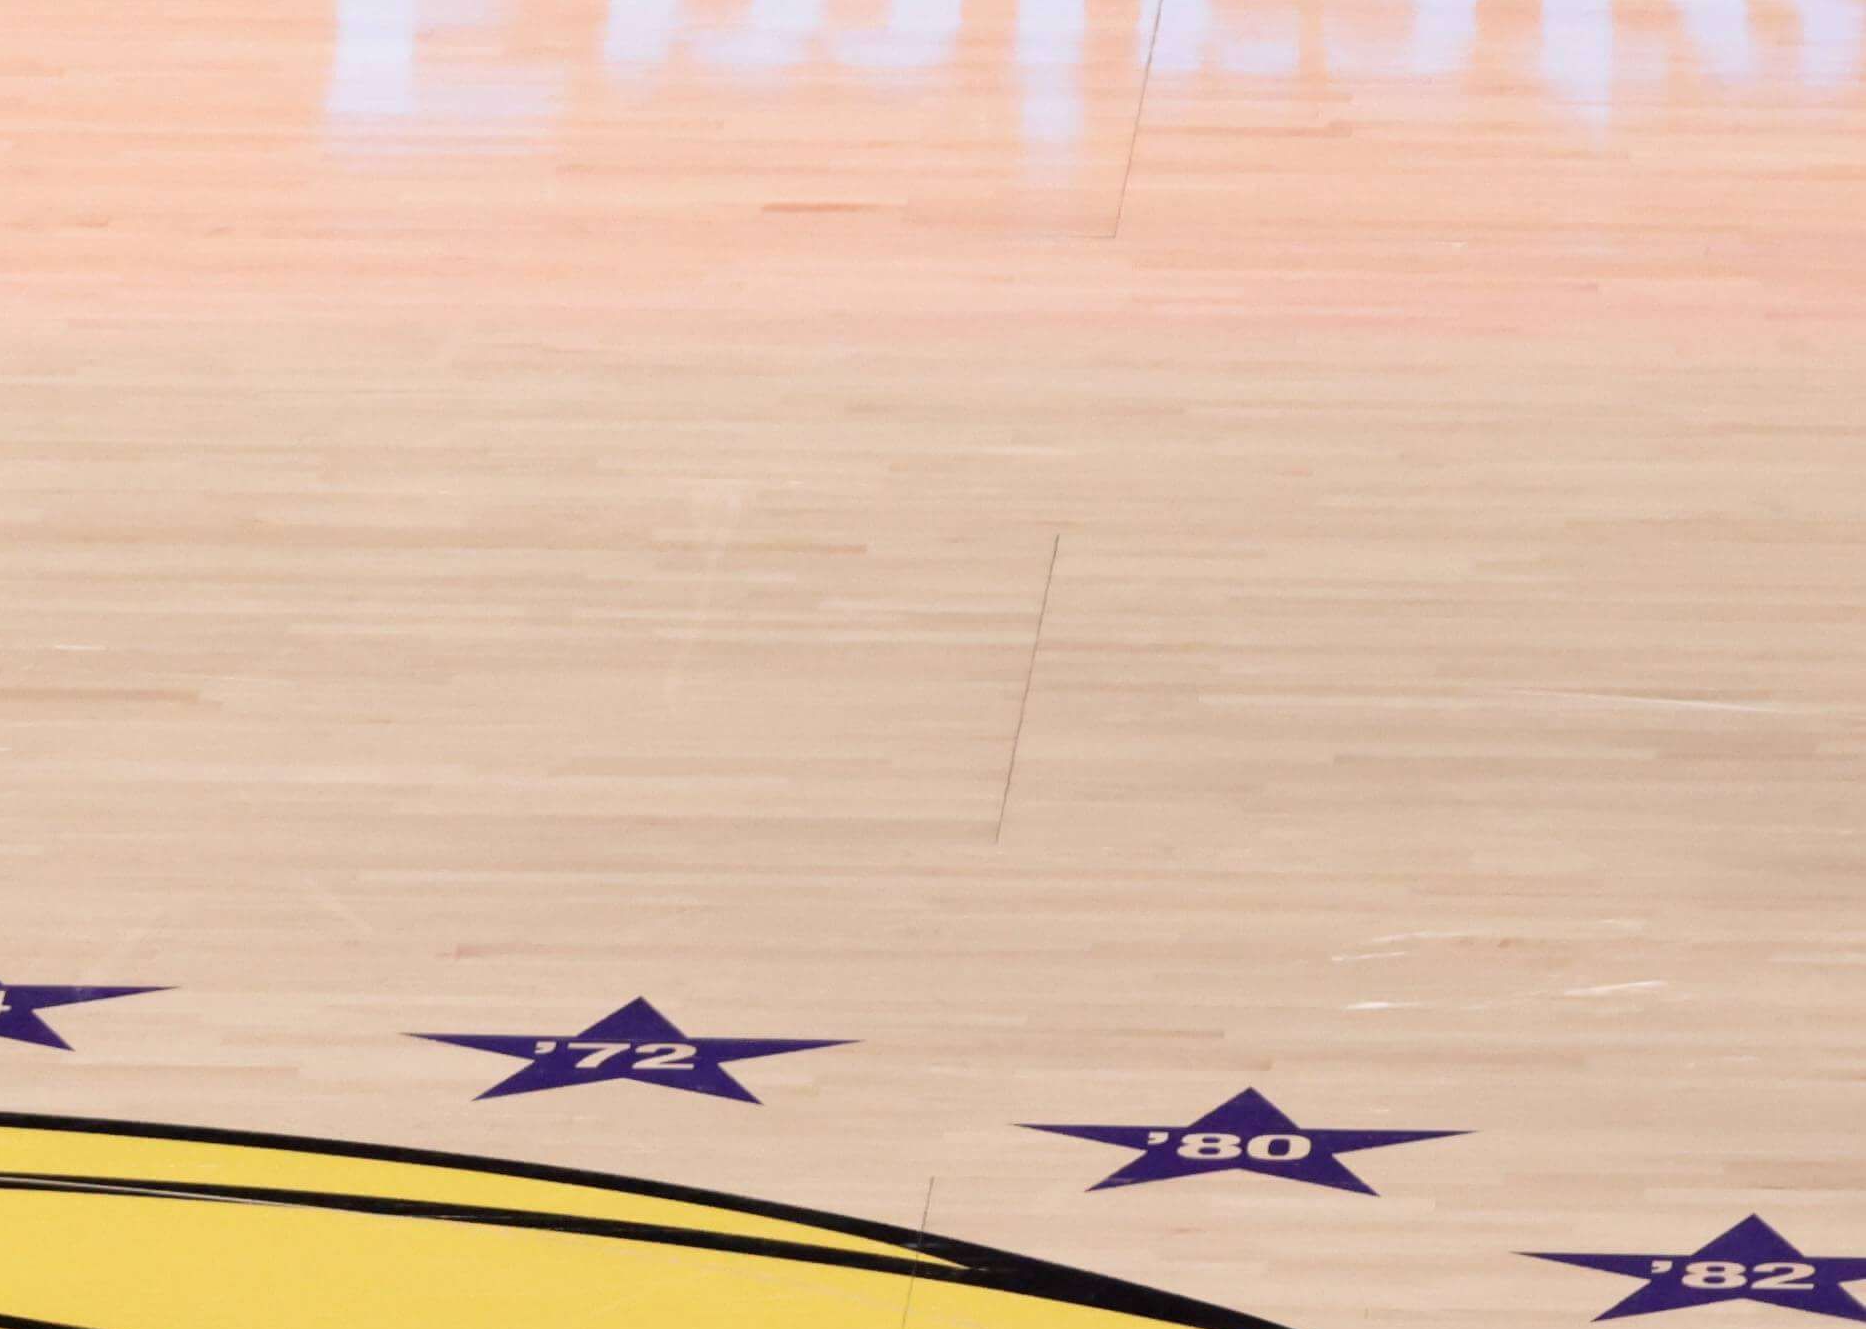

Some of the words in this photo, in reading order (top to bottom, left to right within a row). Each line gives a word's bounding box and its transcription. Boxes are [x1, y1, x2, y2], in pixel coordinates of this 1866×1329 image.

[533, 1038, 699, 1071] '72
[1145, 1130, 1313, 1162] '80
[1647, 1257, 1817, 1291] '82
